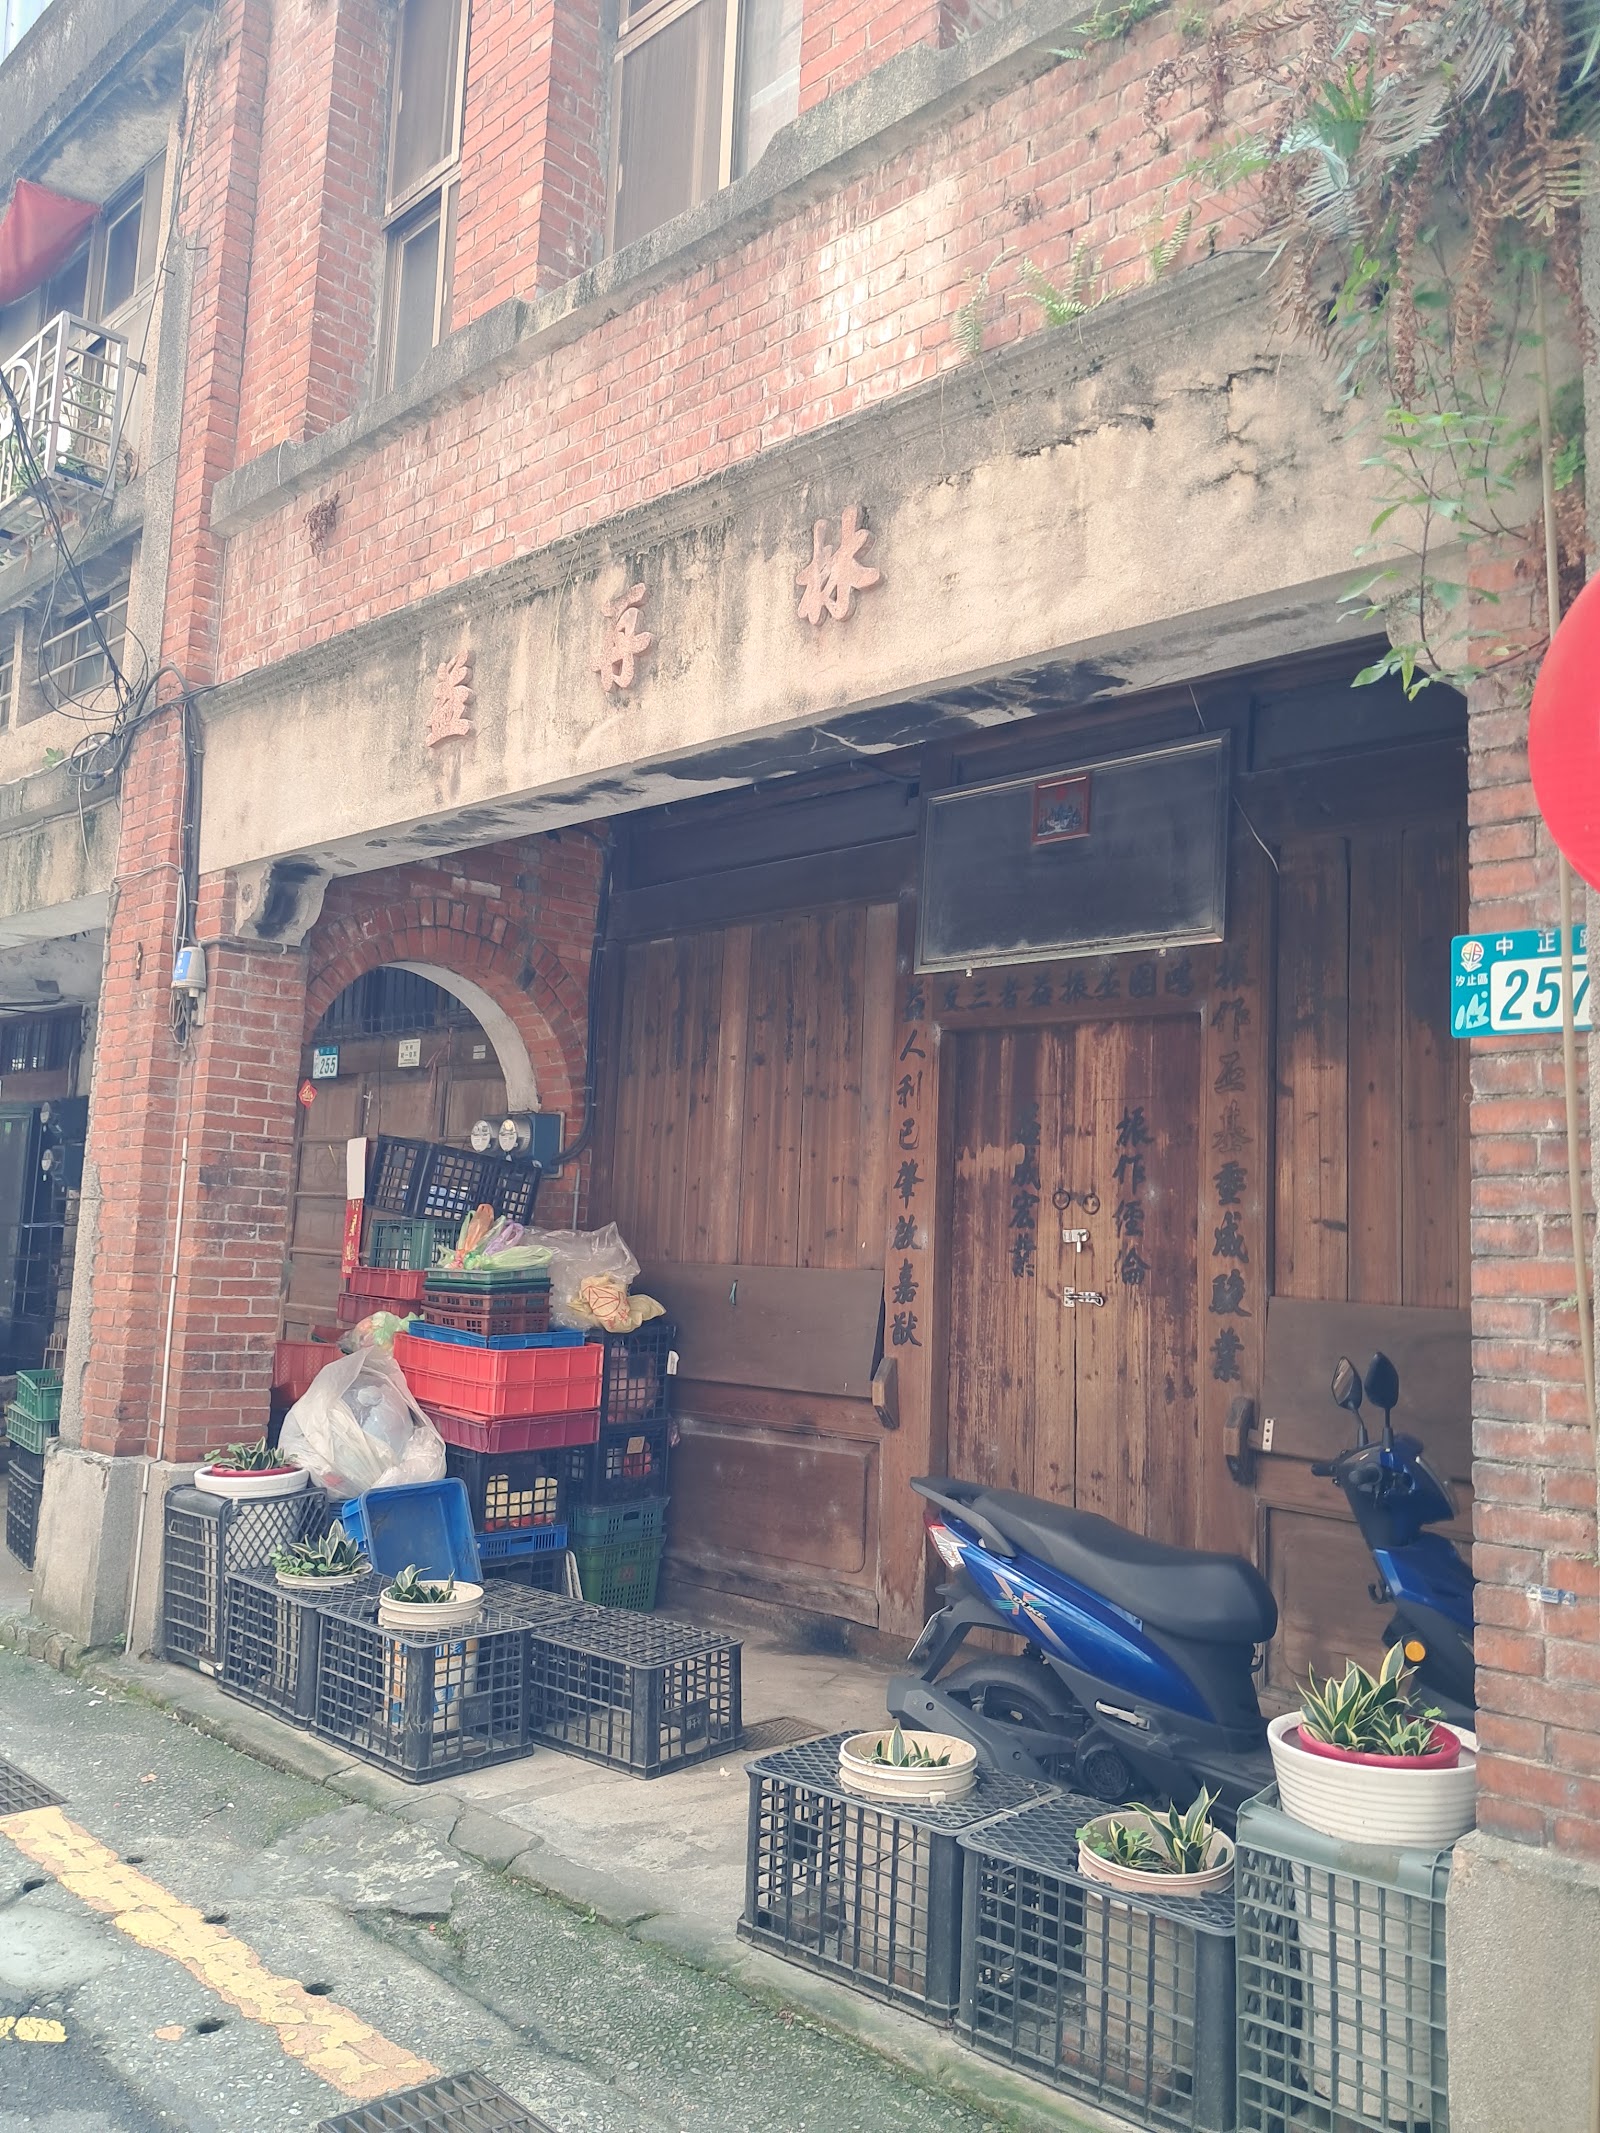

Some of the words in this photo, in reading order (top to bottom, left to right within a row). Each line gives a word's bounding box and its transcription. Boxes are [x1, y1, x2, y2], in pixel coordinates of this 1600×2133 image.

[1455, 972, 1489, 988] 汐止區
[319, 1057, 336, 1075] 255
